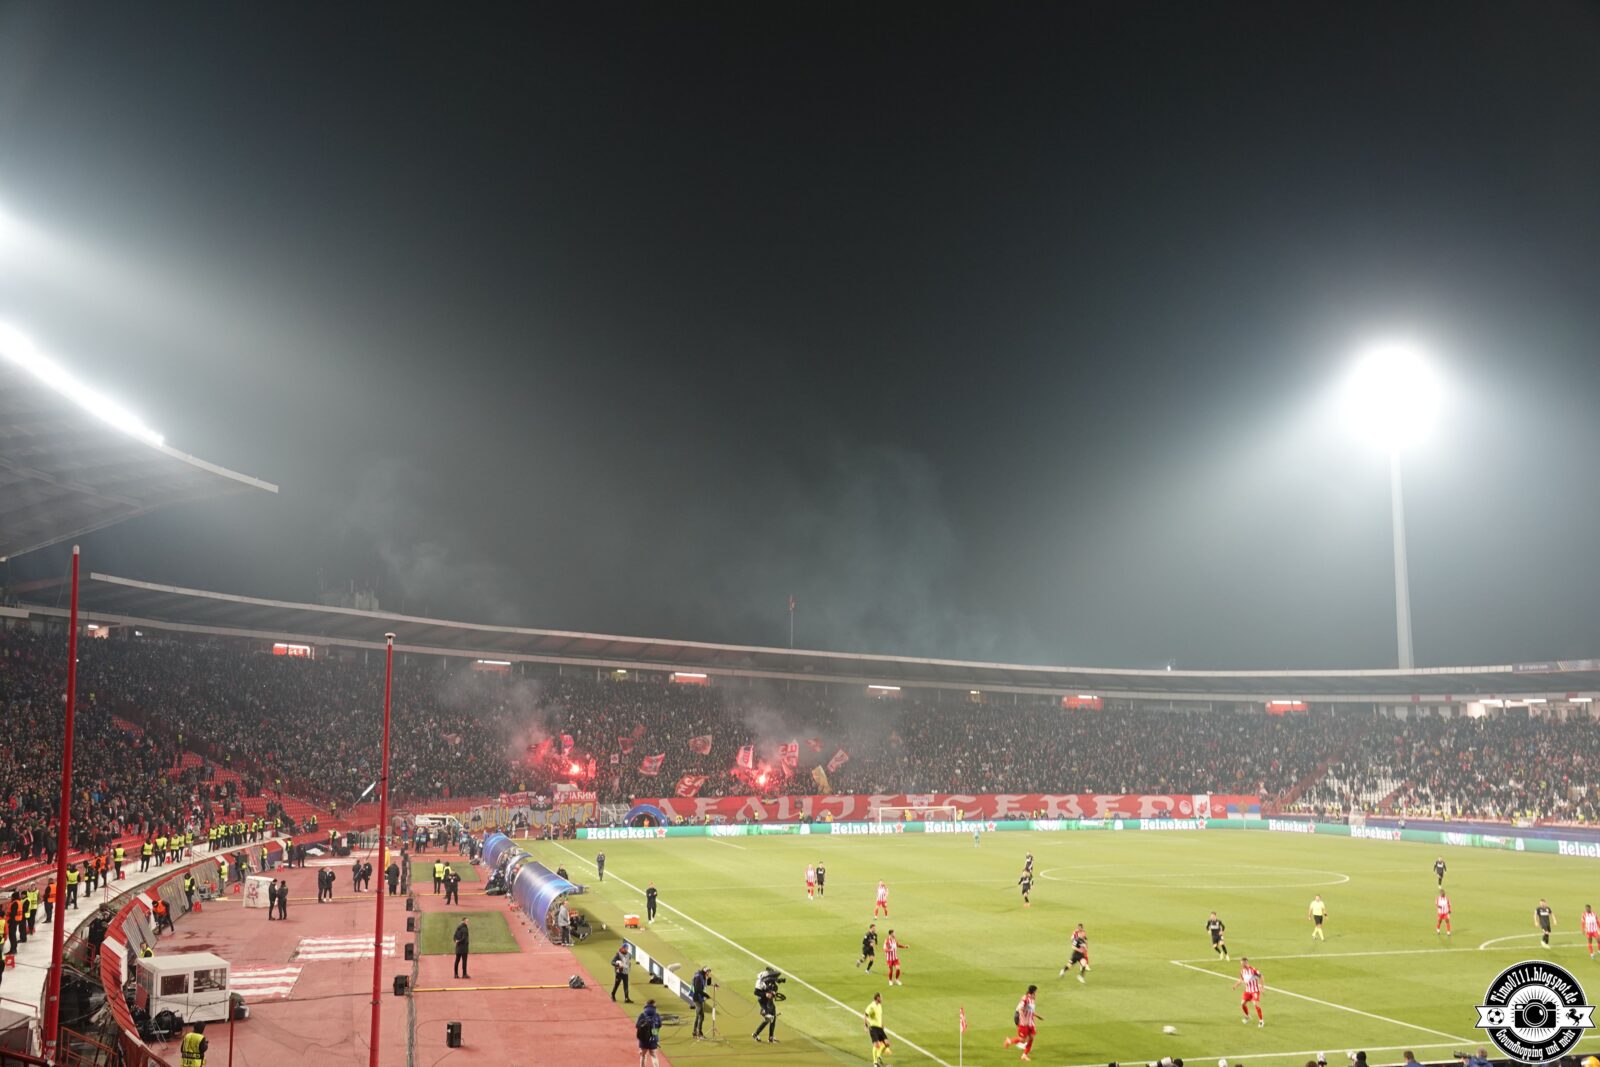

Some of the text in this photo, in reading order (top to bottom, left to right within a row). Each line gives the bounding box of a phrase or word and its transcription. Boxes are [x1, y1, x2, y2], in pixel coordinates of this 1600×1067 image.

[830, 822, 893, 835] Heineken
[924, 821, 985, 833] Heineken
[1140, 819, 1197, 830] Heineken
[1268, 819, 1308, 833] Heineken
[587, 827, 654, 840] Heineken
[1350, 825, 1393, 840] Heineken
